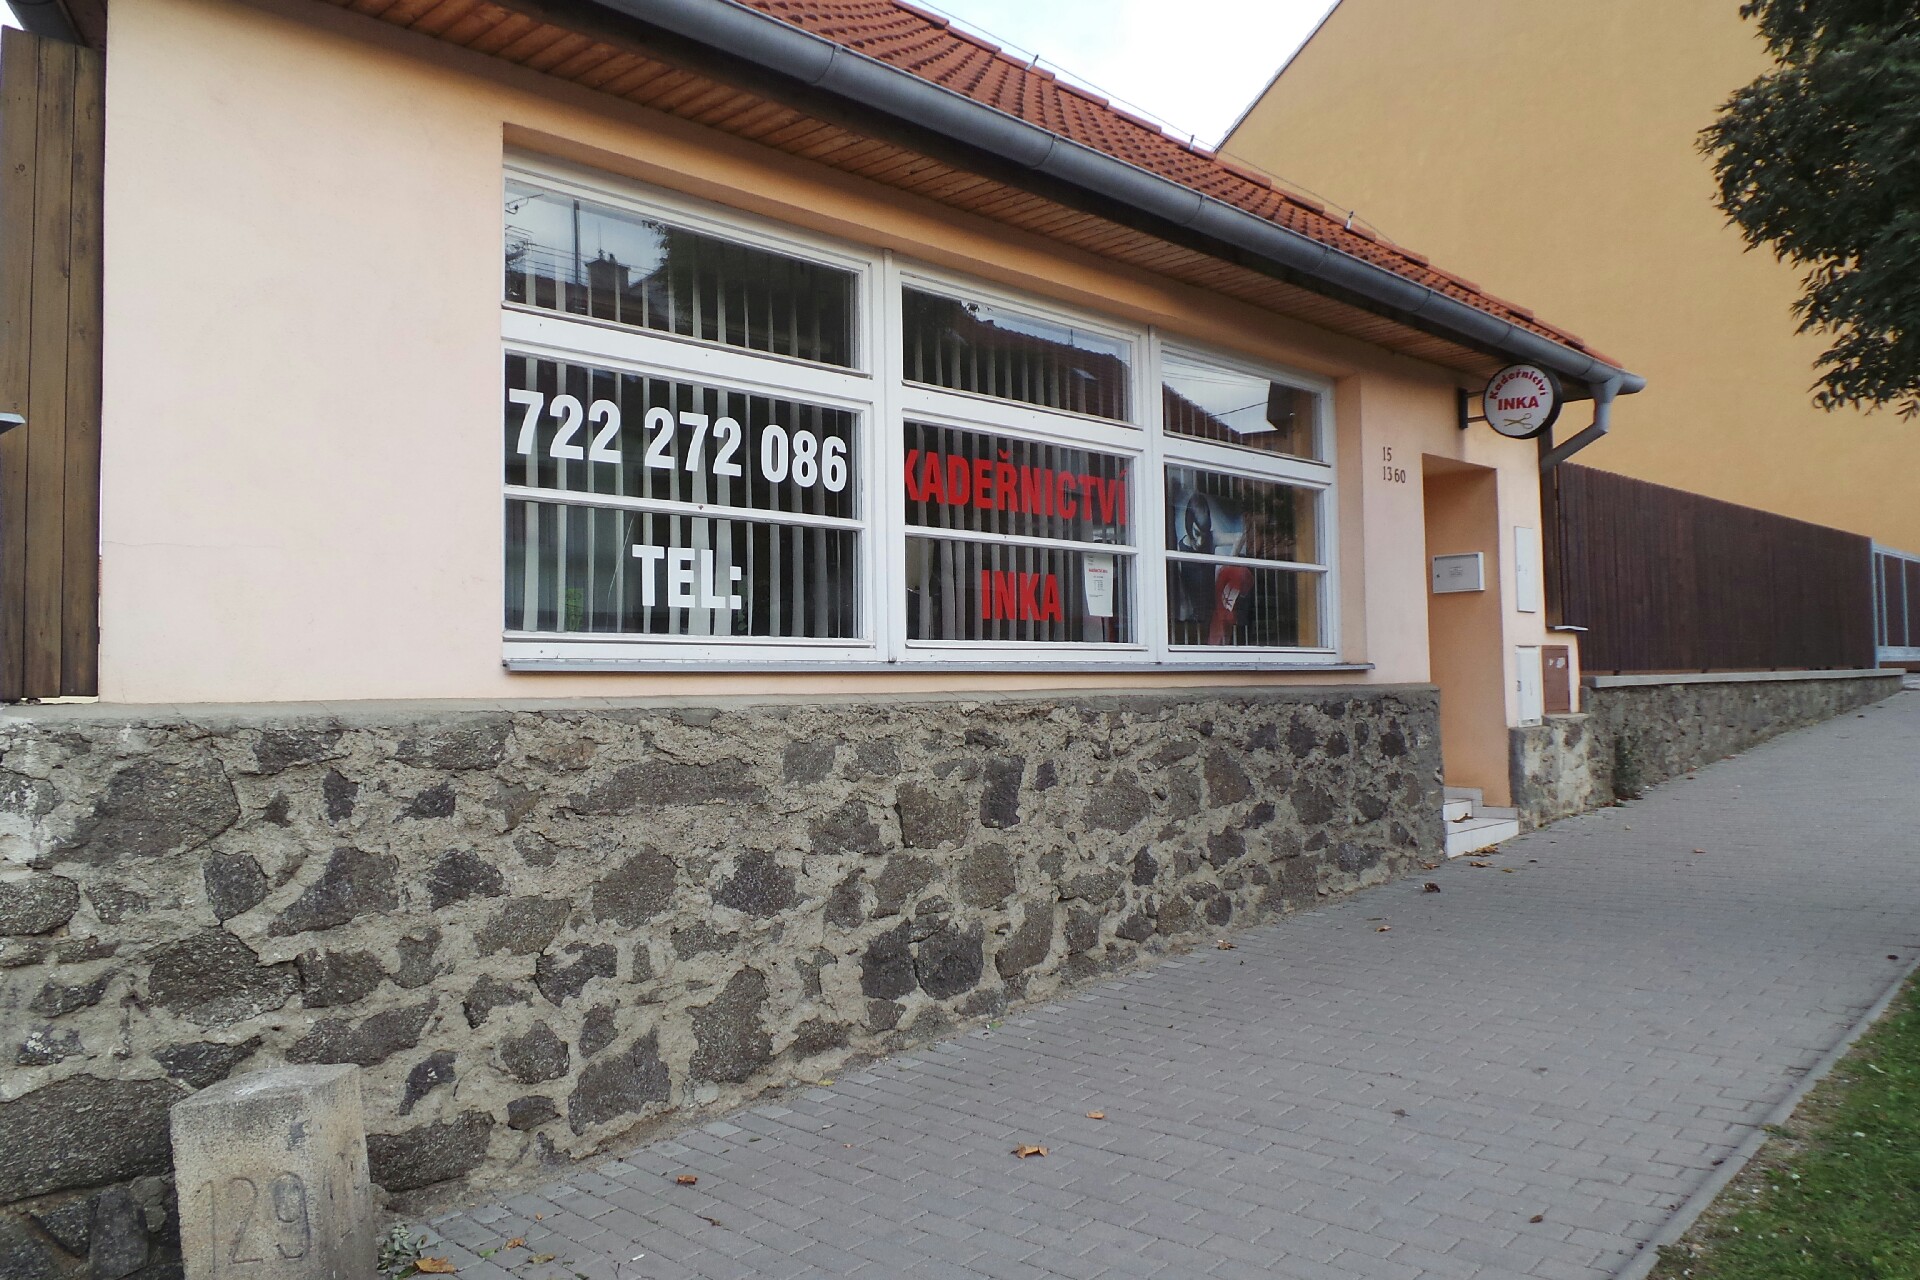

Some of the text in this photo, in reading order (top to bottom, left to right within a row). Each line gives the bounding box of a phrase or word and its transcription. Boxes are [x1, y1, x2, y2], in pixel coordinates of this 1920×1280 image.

[1498, 395, 1539, 411] INKA
[509, 388, 848, 493] 722 272 086
[1383, 446, 1392, 461] 15
[632, 545, 742, 610] TEL:
[981, 569, 1063, 622] INKA
[192, 1171, 311, 1272] 129
